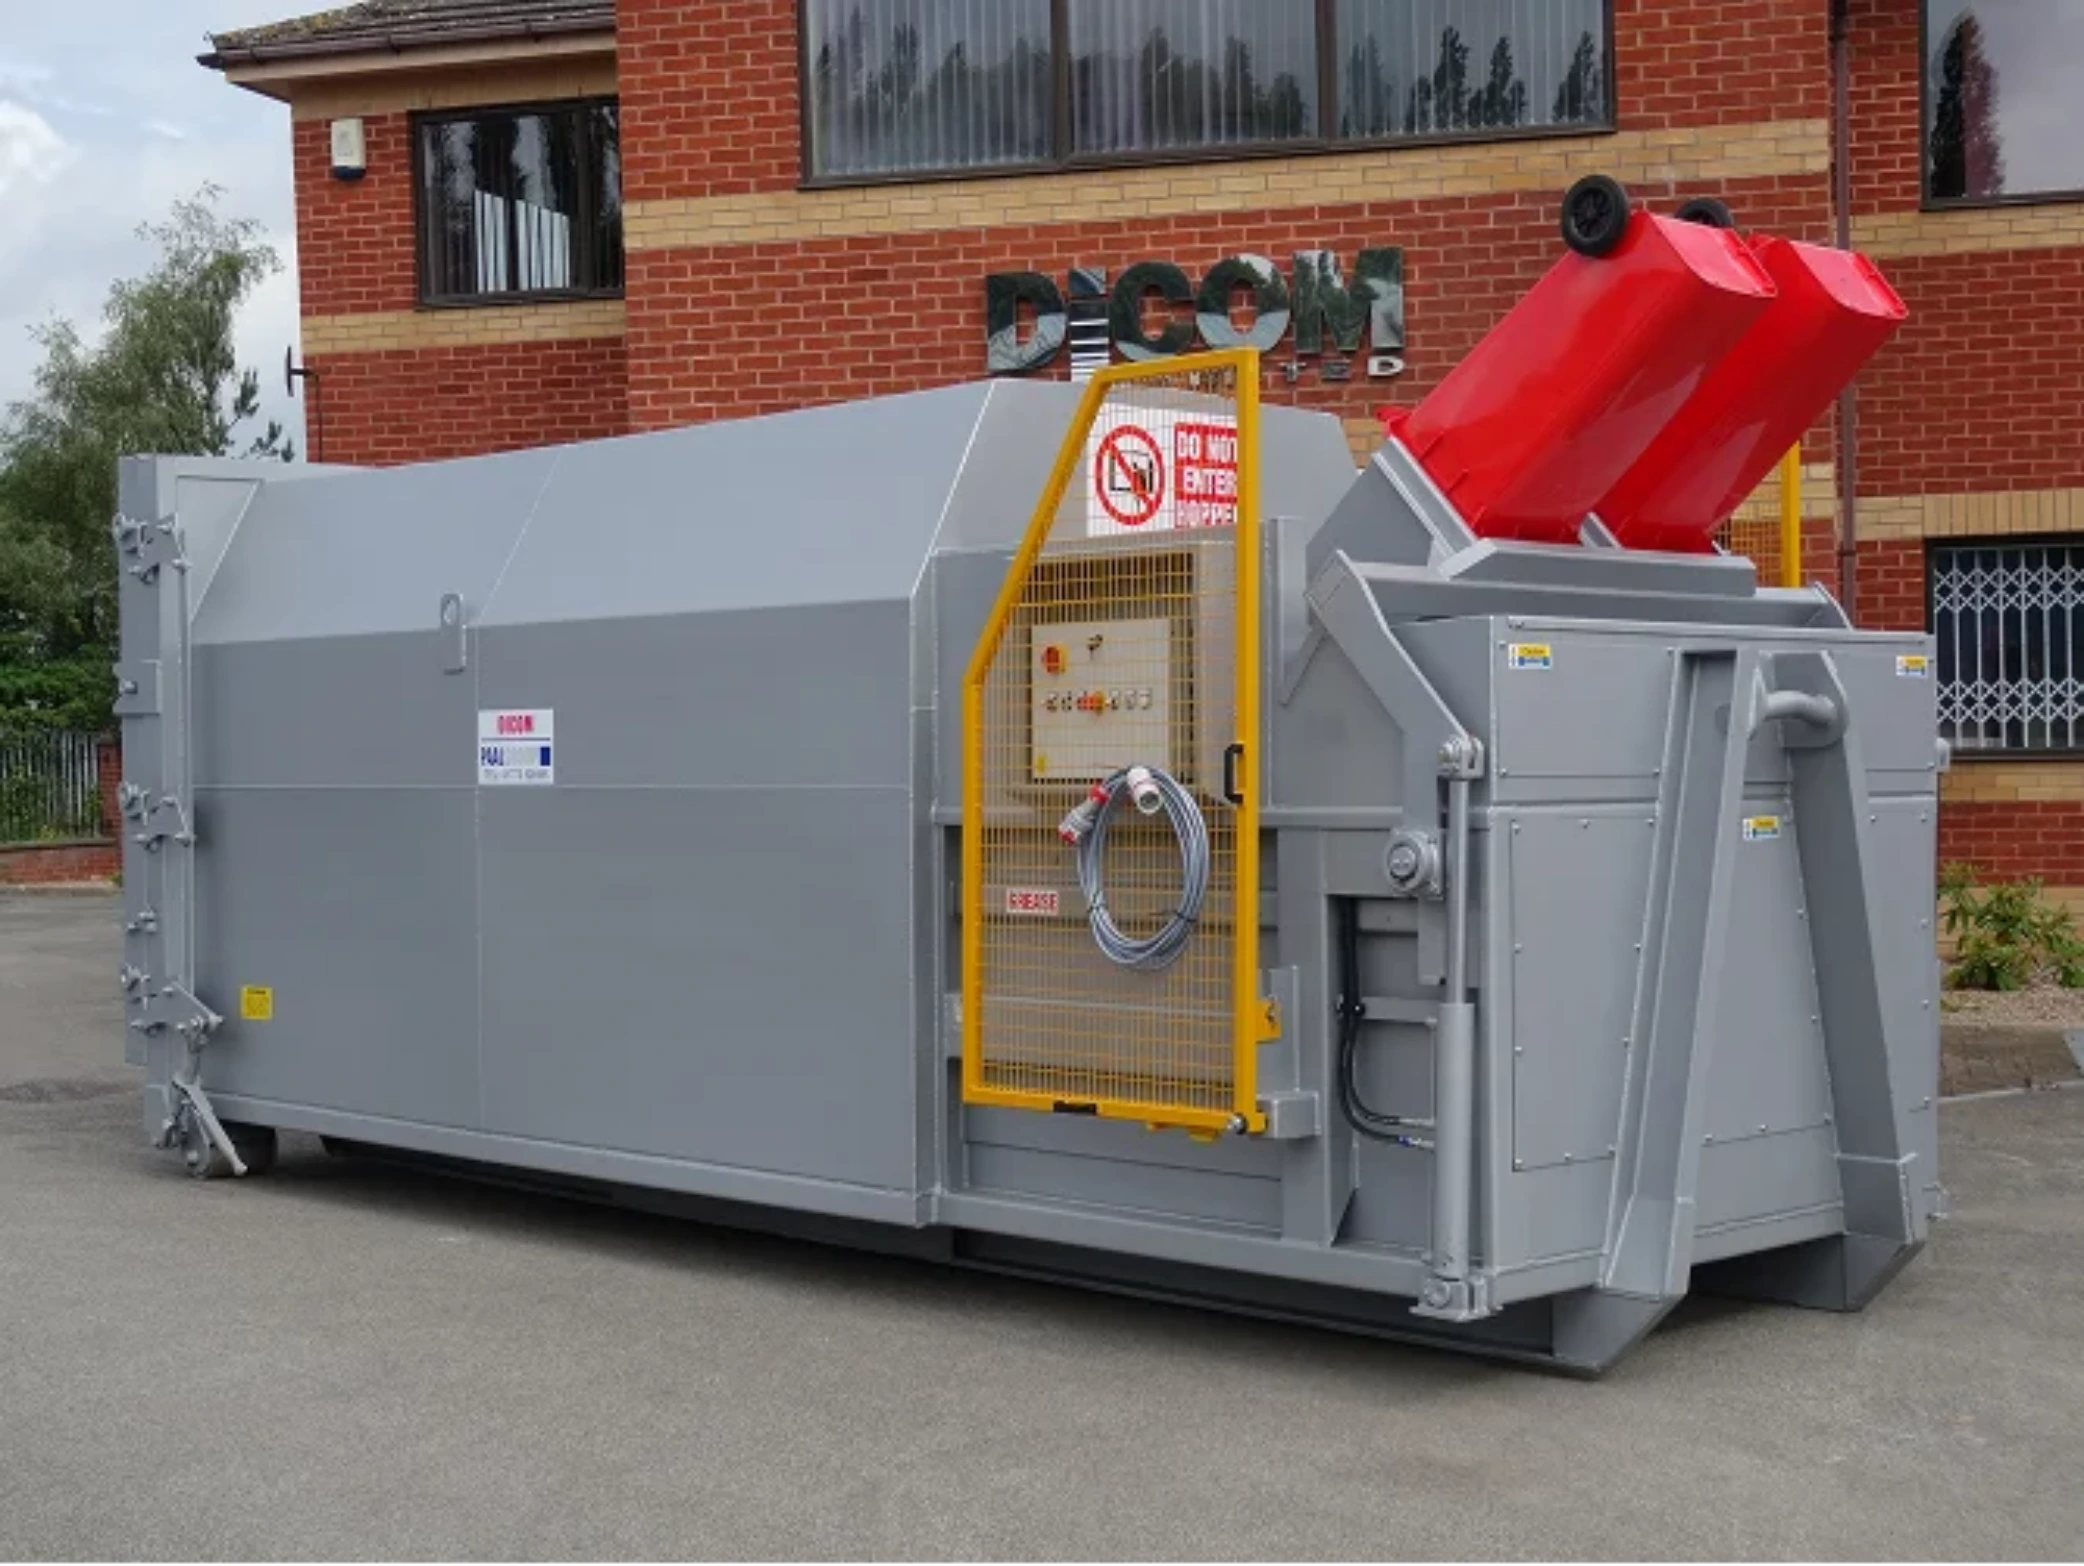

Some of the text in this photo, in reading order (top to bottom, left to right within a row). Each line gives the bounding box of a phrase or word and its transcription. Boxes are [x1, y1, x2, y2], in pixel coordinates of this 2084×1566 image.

[1177, 429, 1200, 459] DO
[1177, 498, 1238, 529] HOPPE
[1010, 893, 1057, 909] GREASE
